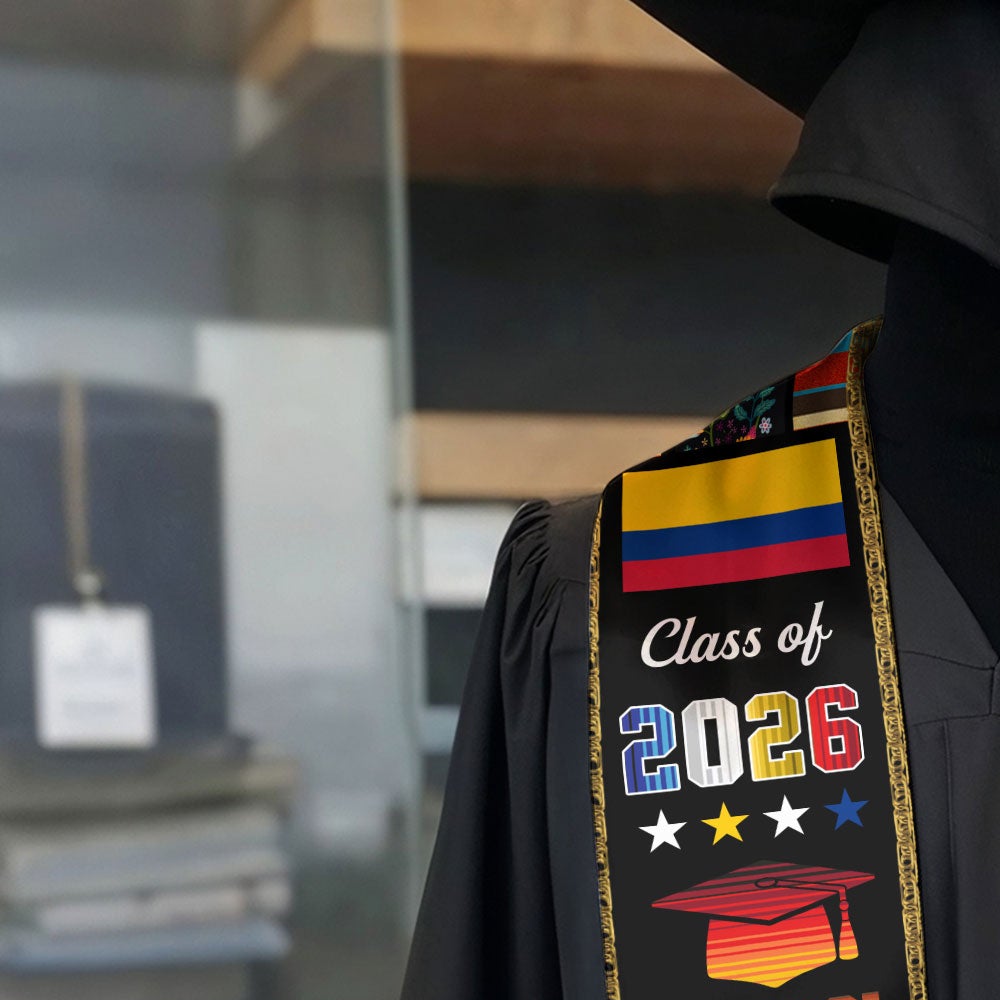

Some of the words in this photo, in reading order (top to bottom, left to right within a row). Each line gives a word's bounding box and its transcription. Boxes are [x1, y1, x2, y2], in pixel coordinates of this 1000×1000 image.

[641, 616, 762, 668] Class
[777, 600, 833, 666] of
[619, 683, 865, 795] 2026
